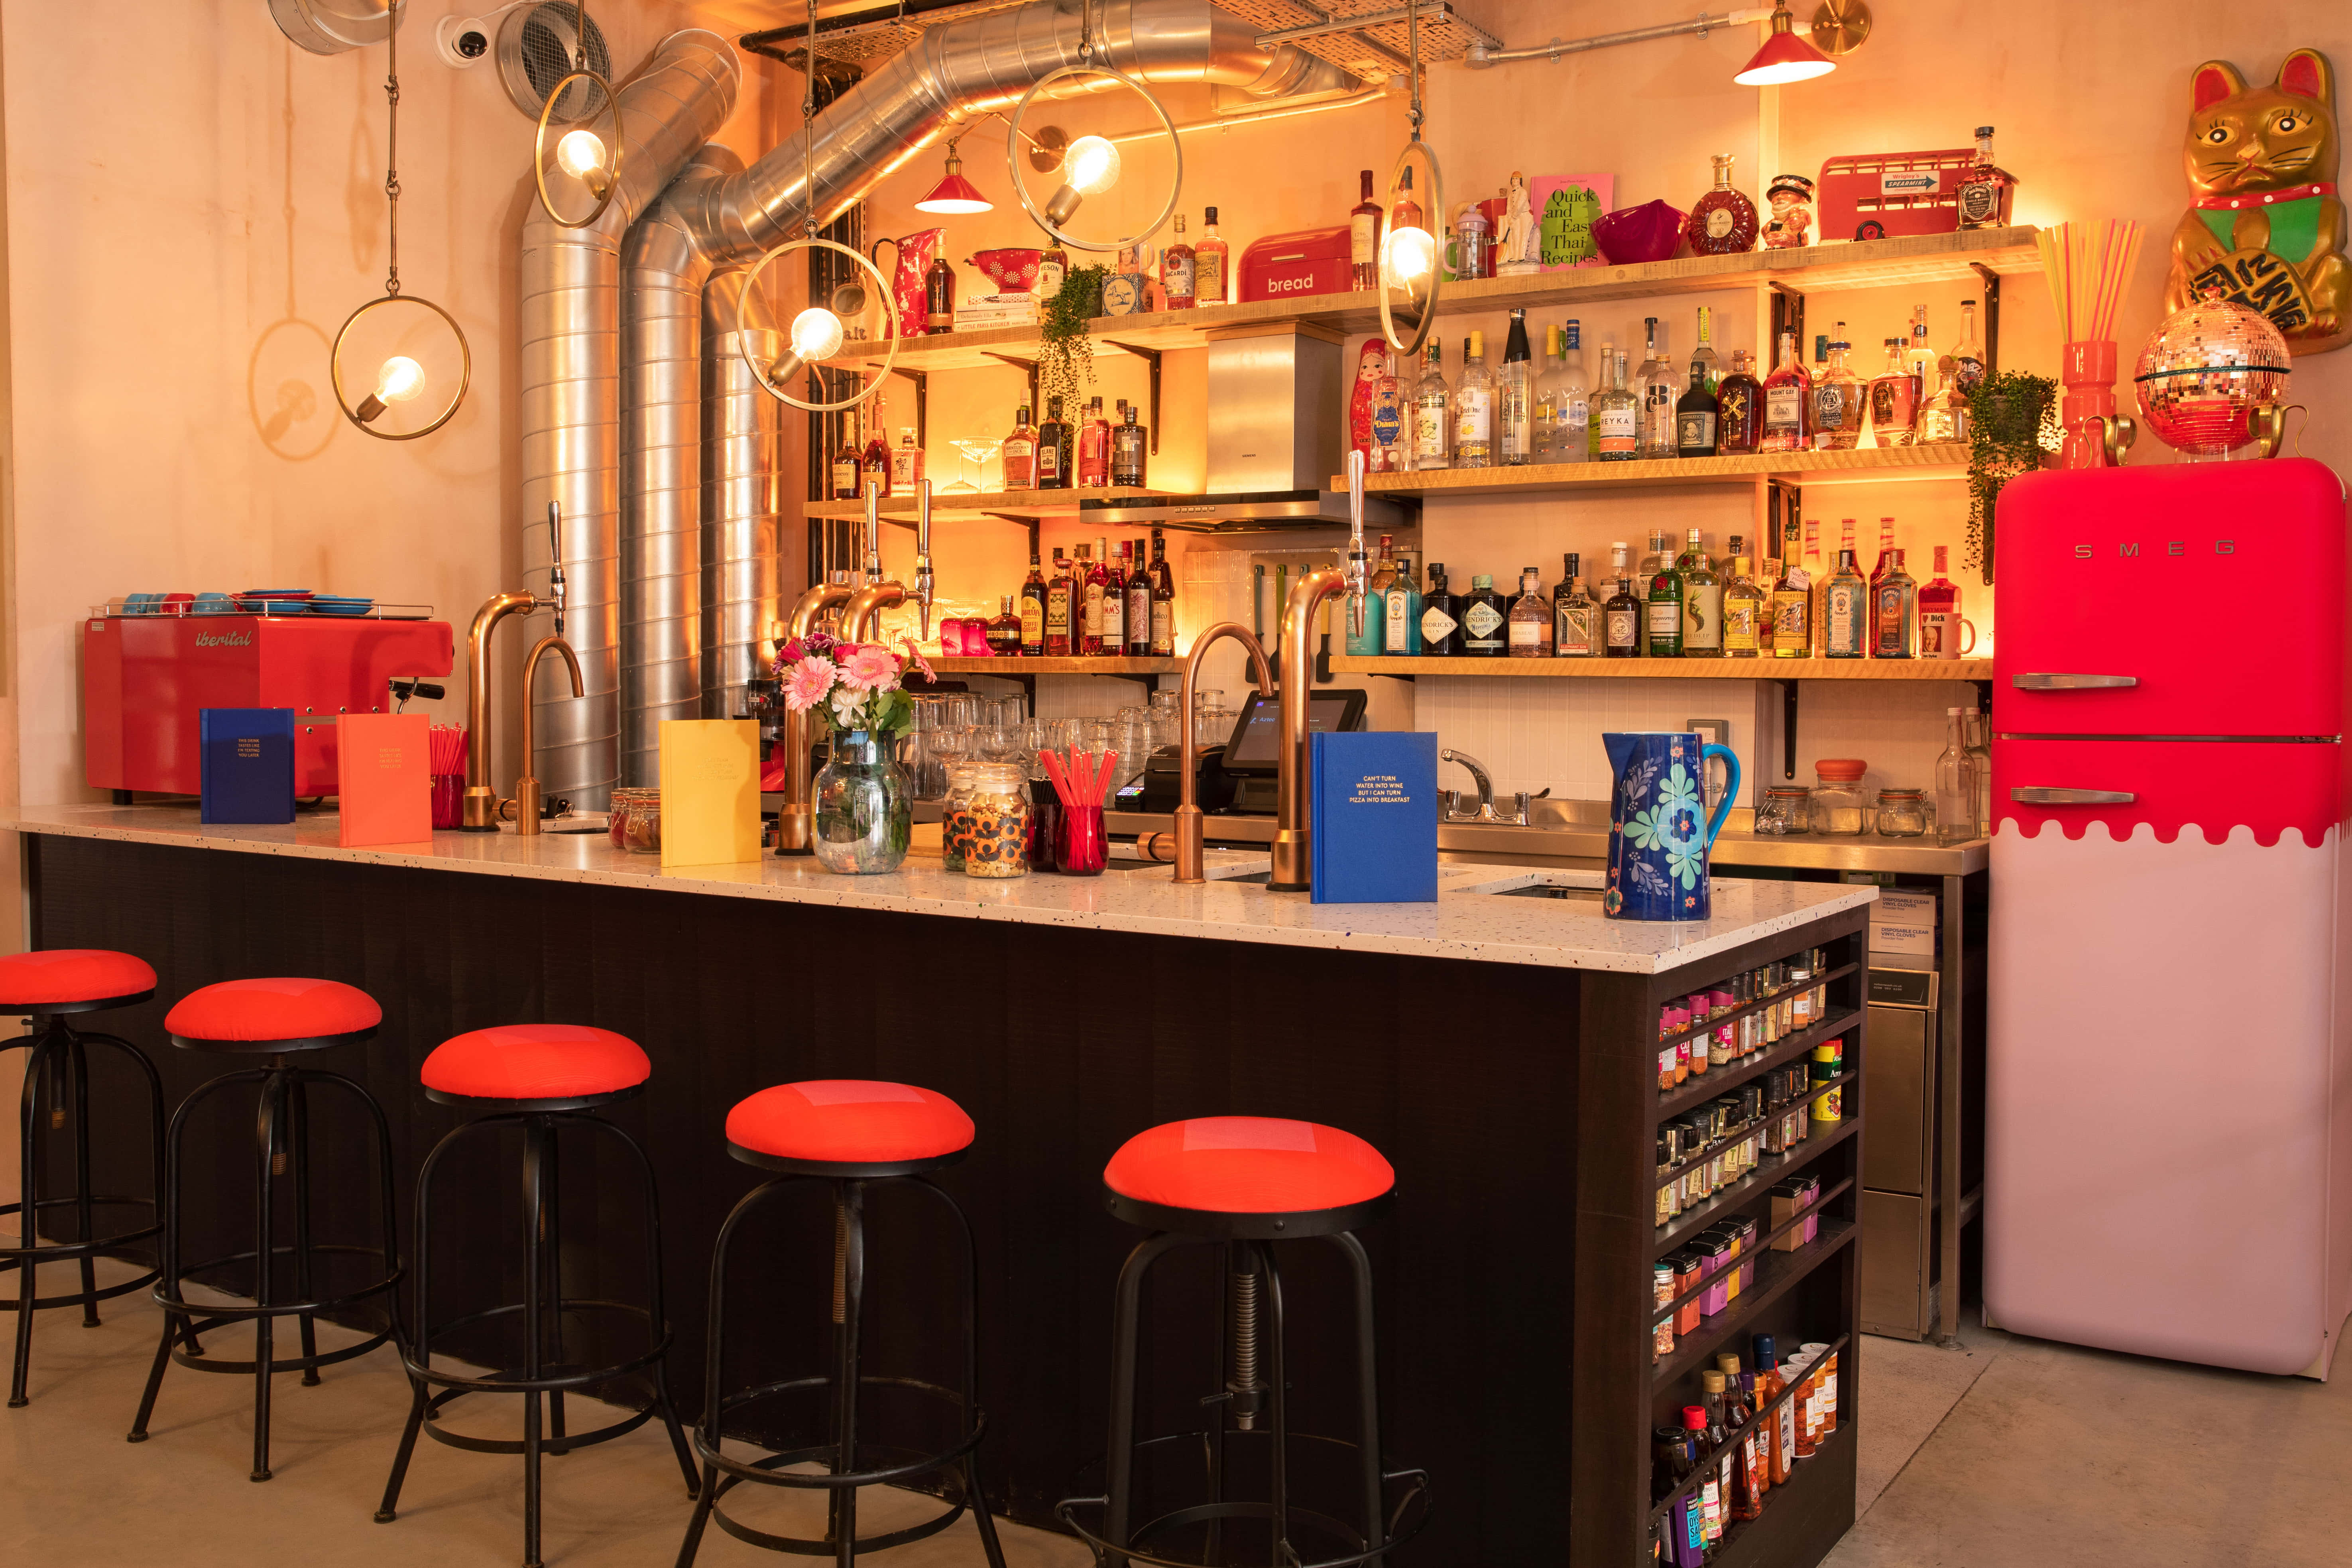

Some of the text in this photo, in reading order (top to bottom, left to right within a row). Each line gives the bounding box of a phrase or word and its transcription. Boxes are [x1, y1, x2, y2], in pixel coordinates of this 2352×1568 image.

[1552, 187, 1595, 207] Quick
[1546, 203, 1572, 218] and
[1551, 234, 1585, 249] Thai
[1540, 250, 1598, 267] Recipes
[1268, 273, 1313, 293] bread
[843, 327, 867, 340] alt
[2075, 540, 2235, 559] SMEG
[1650, 614, 1676, 623] Tanqueray
[195, 631, 252, 647] iberital
[1689, 1514, 1699, 1527] OYS
